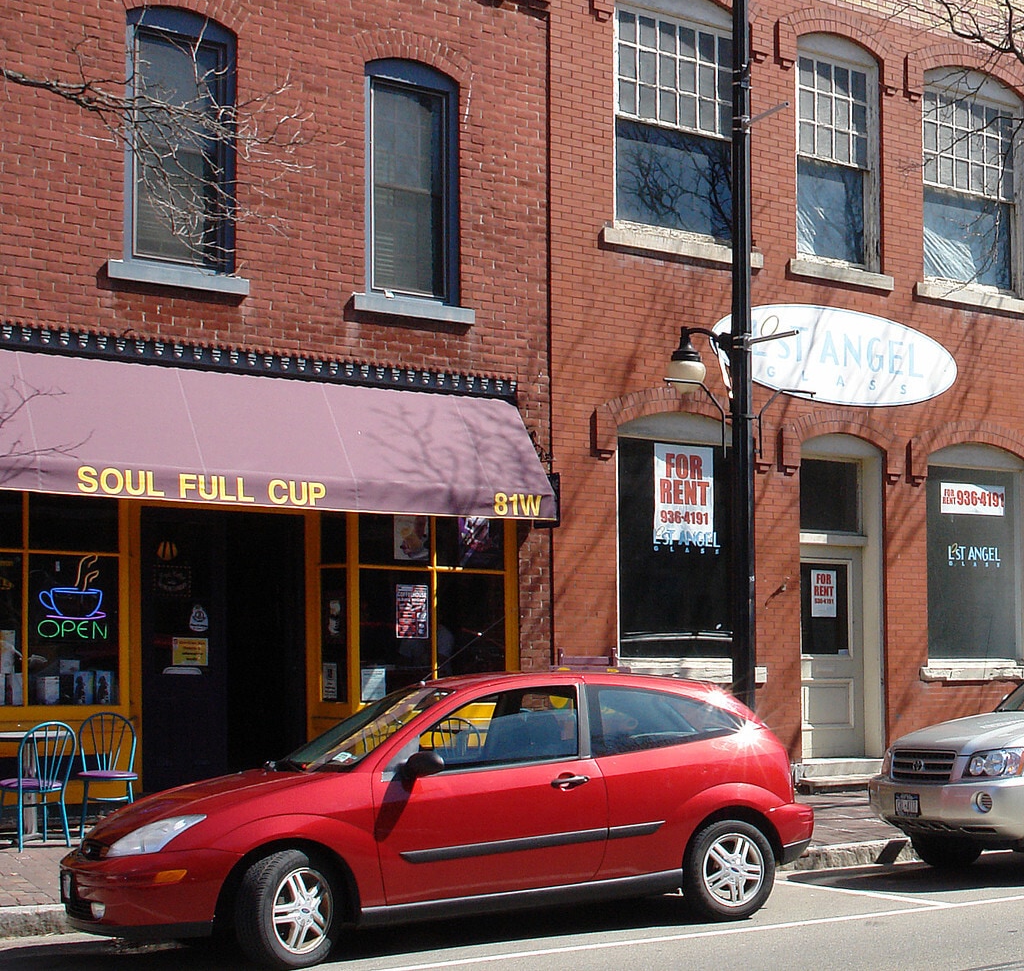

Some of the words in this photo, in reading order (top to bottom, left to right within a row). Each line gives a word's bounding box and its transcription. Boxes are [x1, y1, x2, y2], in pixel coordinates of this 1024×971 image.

[820, 330, 923, 378] ANGEL
[766, 366, 907, 394] GLASS
[665, 453, 702, 480] FOR
[77, 465, 165, 497] SOUL
[179, 473, 255, 502] FULL
[268, 479, 326, 506] CUP
[660, 479, 709, 506] RENT
[494, 493, 542, 517] 81W
[942, 496, 956, 505] RENT
[956, 490, 1004, 508] 936-4191
[660, 510, 708, 525] 936-4191
[678, 530, 720, 547] ANGEL
[653, 545, 719, 554] GLASS
[967, 546, 1001, 561] ANGEL
[816, 573, 831, 584] FOR
[814, 585, 834, 597] RENT
[38, 620, 108, 639] OPEN
